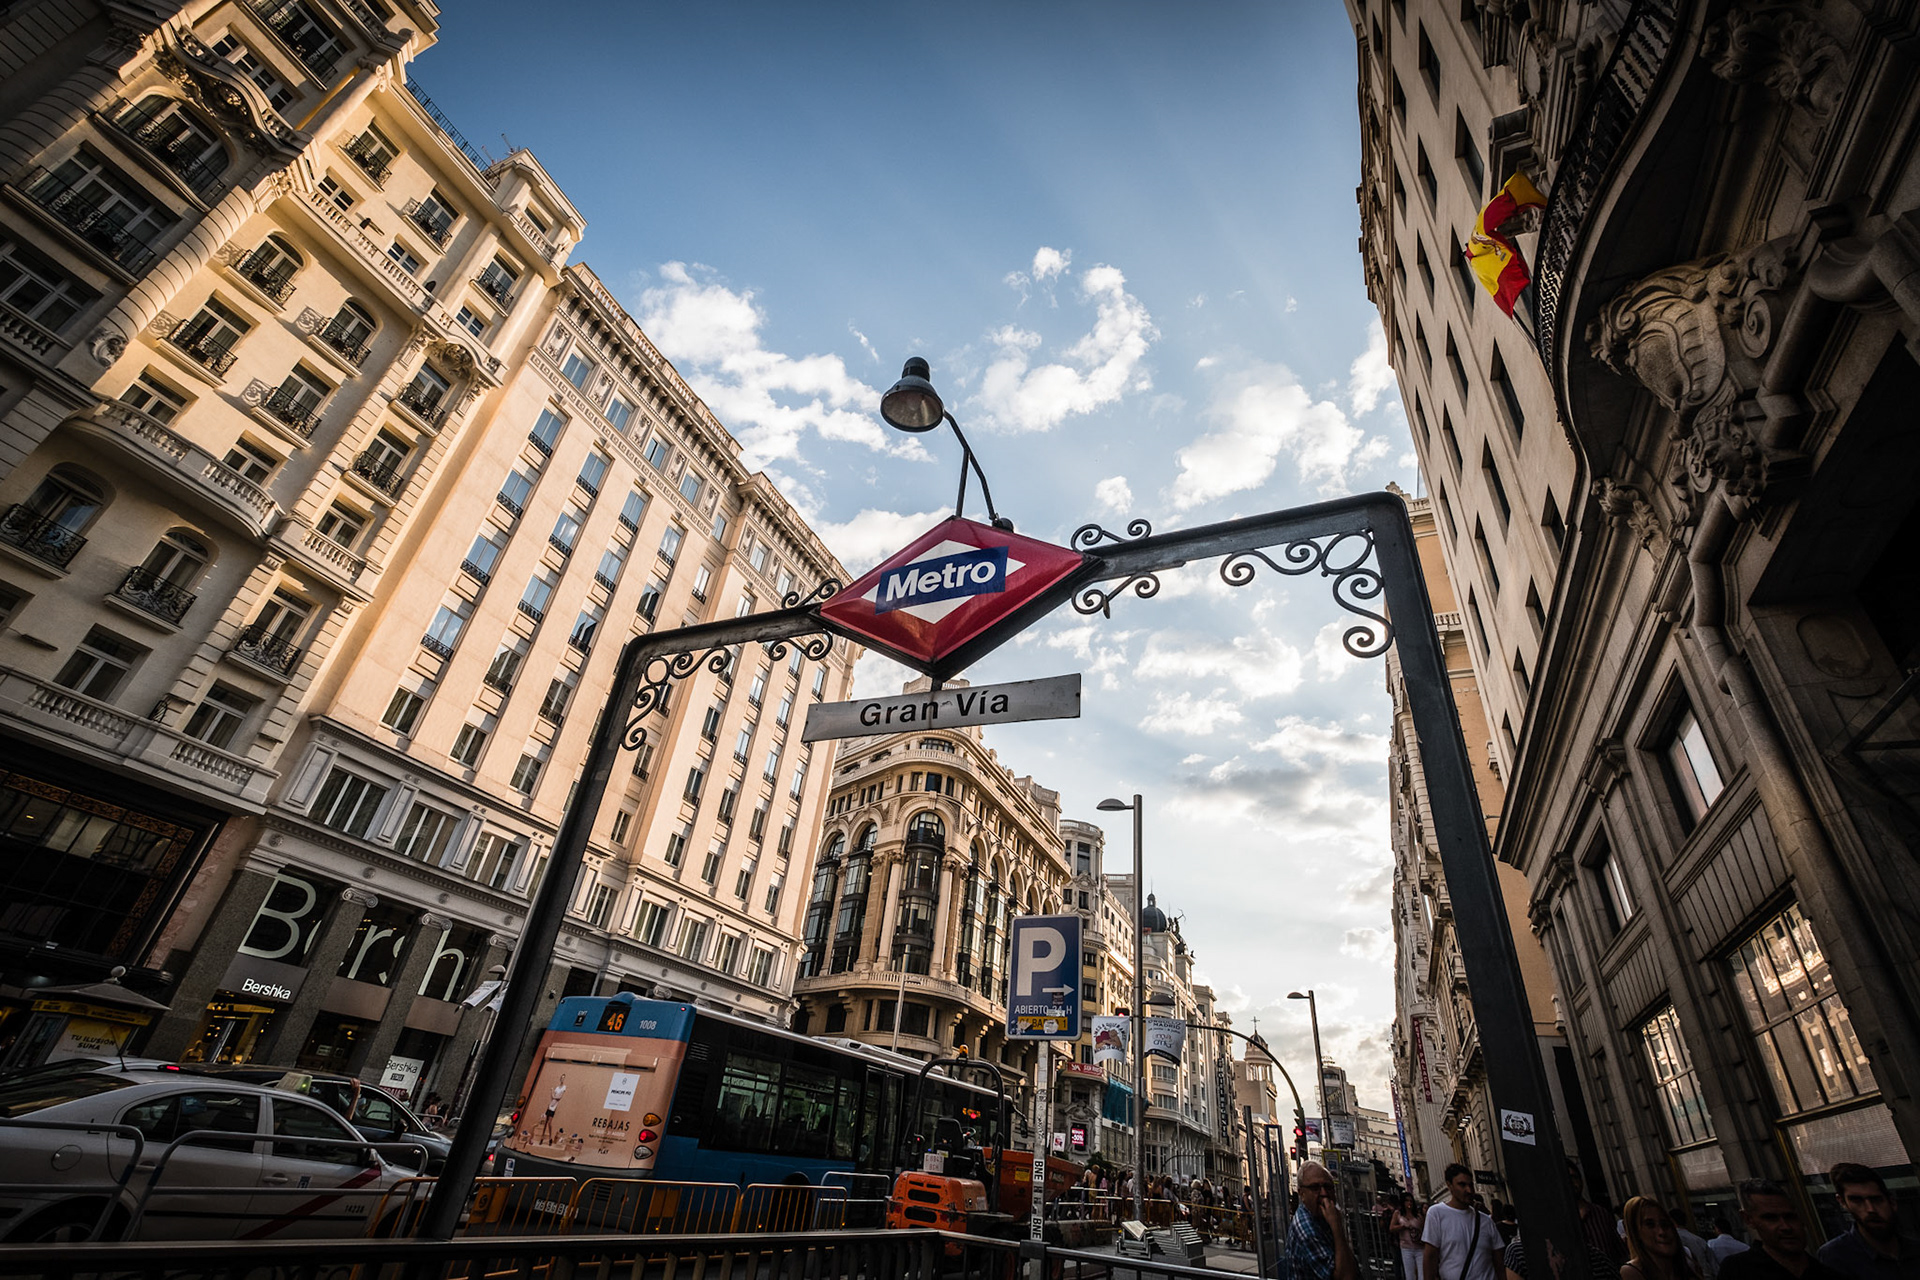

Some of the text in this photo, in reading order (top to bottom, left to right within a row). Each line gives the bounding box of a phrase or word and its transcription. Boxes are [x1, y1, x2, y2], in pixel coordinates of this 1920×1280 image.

[886, 559, 997, 602] Metro
[860, 690, 1009, 727] Gran Vía
[1016, 926, 1067, 996] P
[241, 978, 292, 1000] Bershka
[1014, 1004, 1048, 1015] ABIERTO
[1066, 1005, 1072, 1015] H
[607, 1012, 625, 1031] 46
[639, 1019, 658, 1030] 1008
[1153, 1022, 1181, 1030] MADRID
[77, 1042, 101, 1051] SUMA
[386, 1060, 418, 1073] Bershka
[1419, 1052, 1431, 1088] PALACE
[592, 1117, 630, 1131] REBAJAS
[1034, 1160, 1043, 1180] BNE
[1032, 1217, 1042, 1240] BNE
